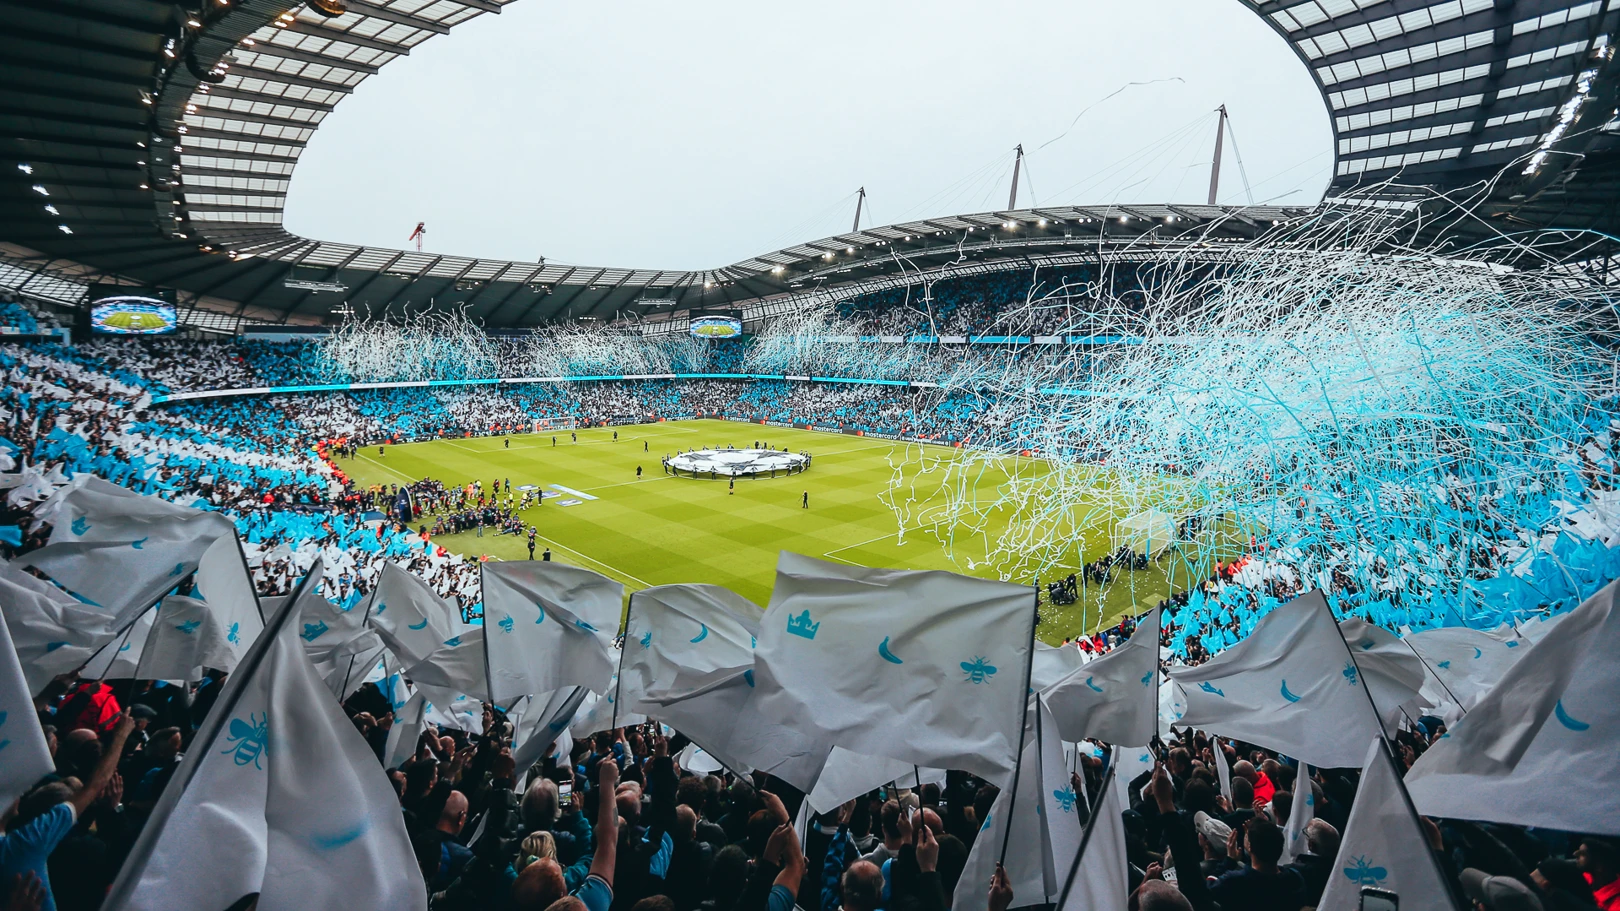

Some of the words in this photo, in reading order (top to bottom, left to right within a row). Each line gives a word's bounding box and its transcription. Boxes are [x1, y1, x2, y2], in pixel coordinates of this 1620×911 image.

[766, 420, 794, 428] mastercard
[813, 424, 843, 434] mastercard
[864, 430, 897, 440] mastercard
